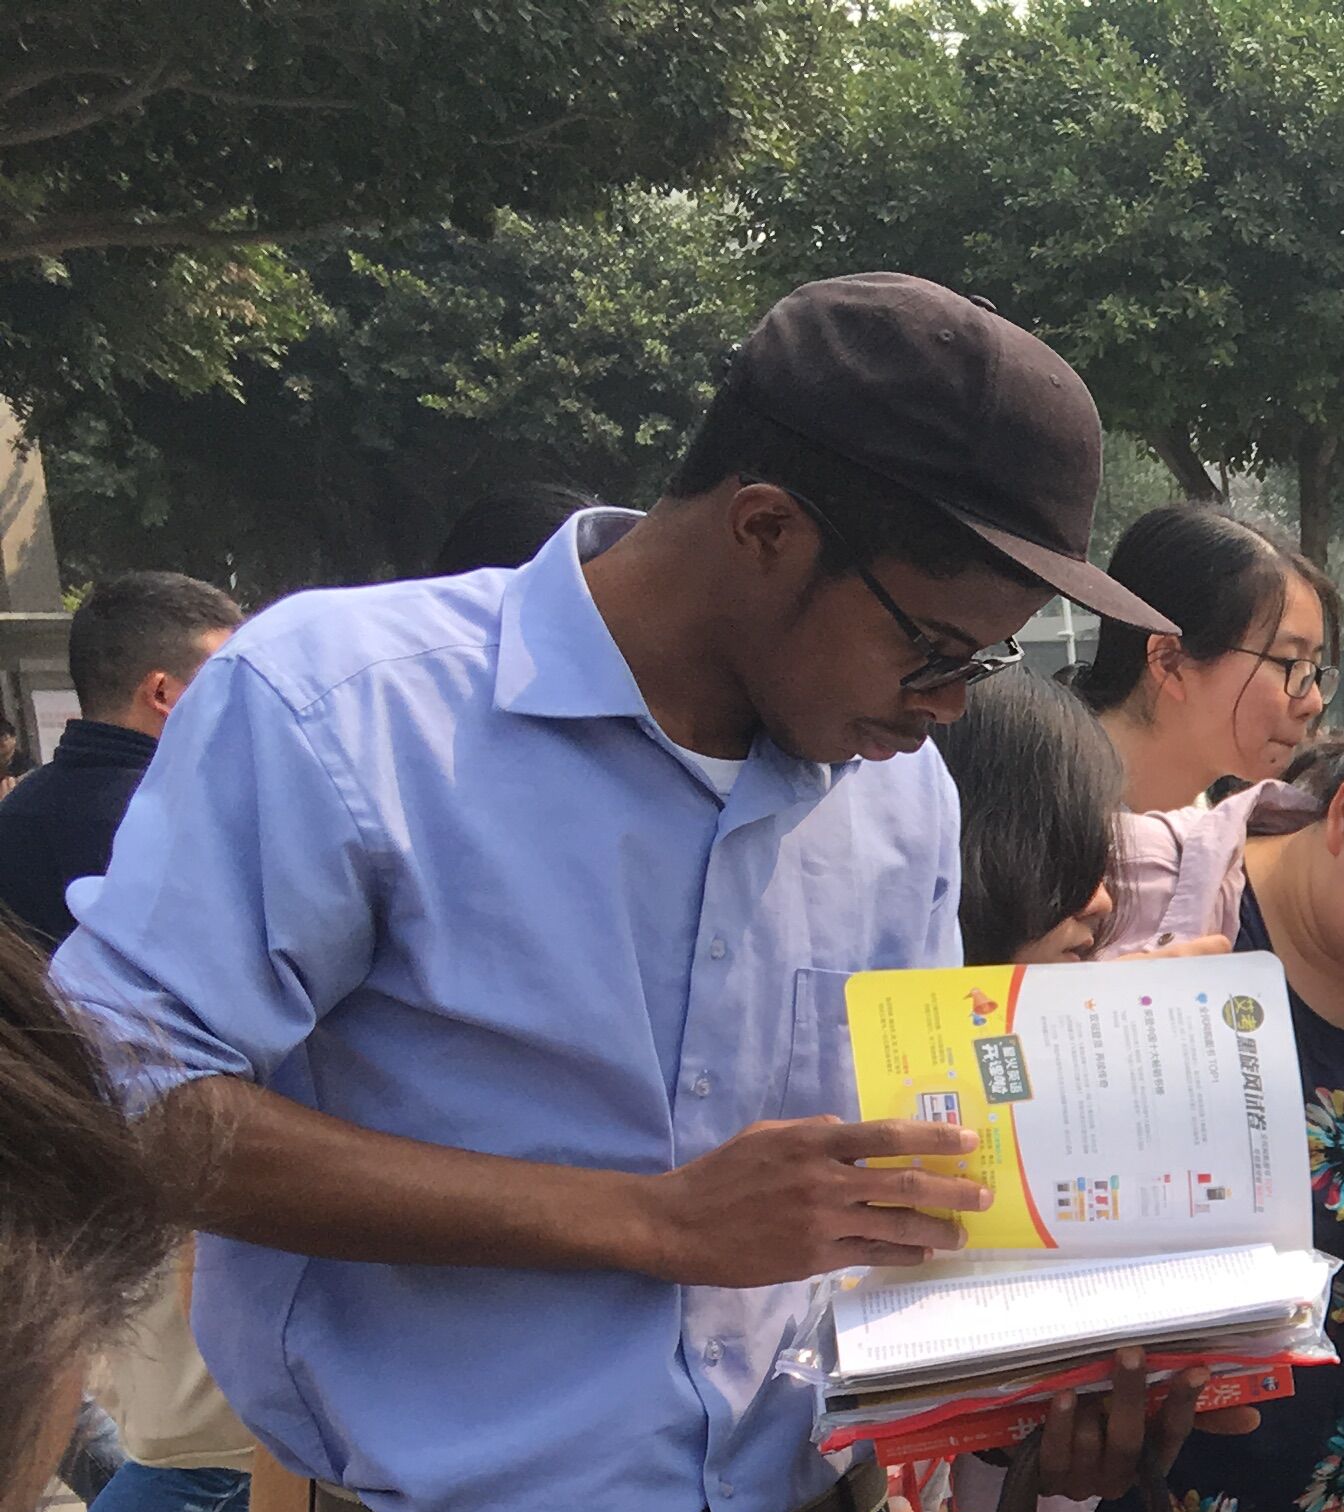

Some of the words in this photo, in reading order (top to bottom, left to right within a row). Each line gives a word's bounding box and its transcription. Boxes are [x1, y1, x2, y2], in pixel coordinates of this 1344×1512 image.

[1207, 1059, 1219, 1084] TOP1
[1236, 1034, 1267, 1132] 黑旋风试卷
